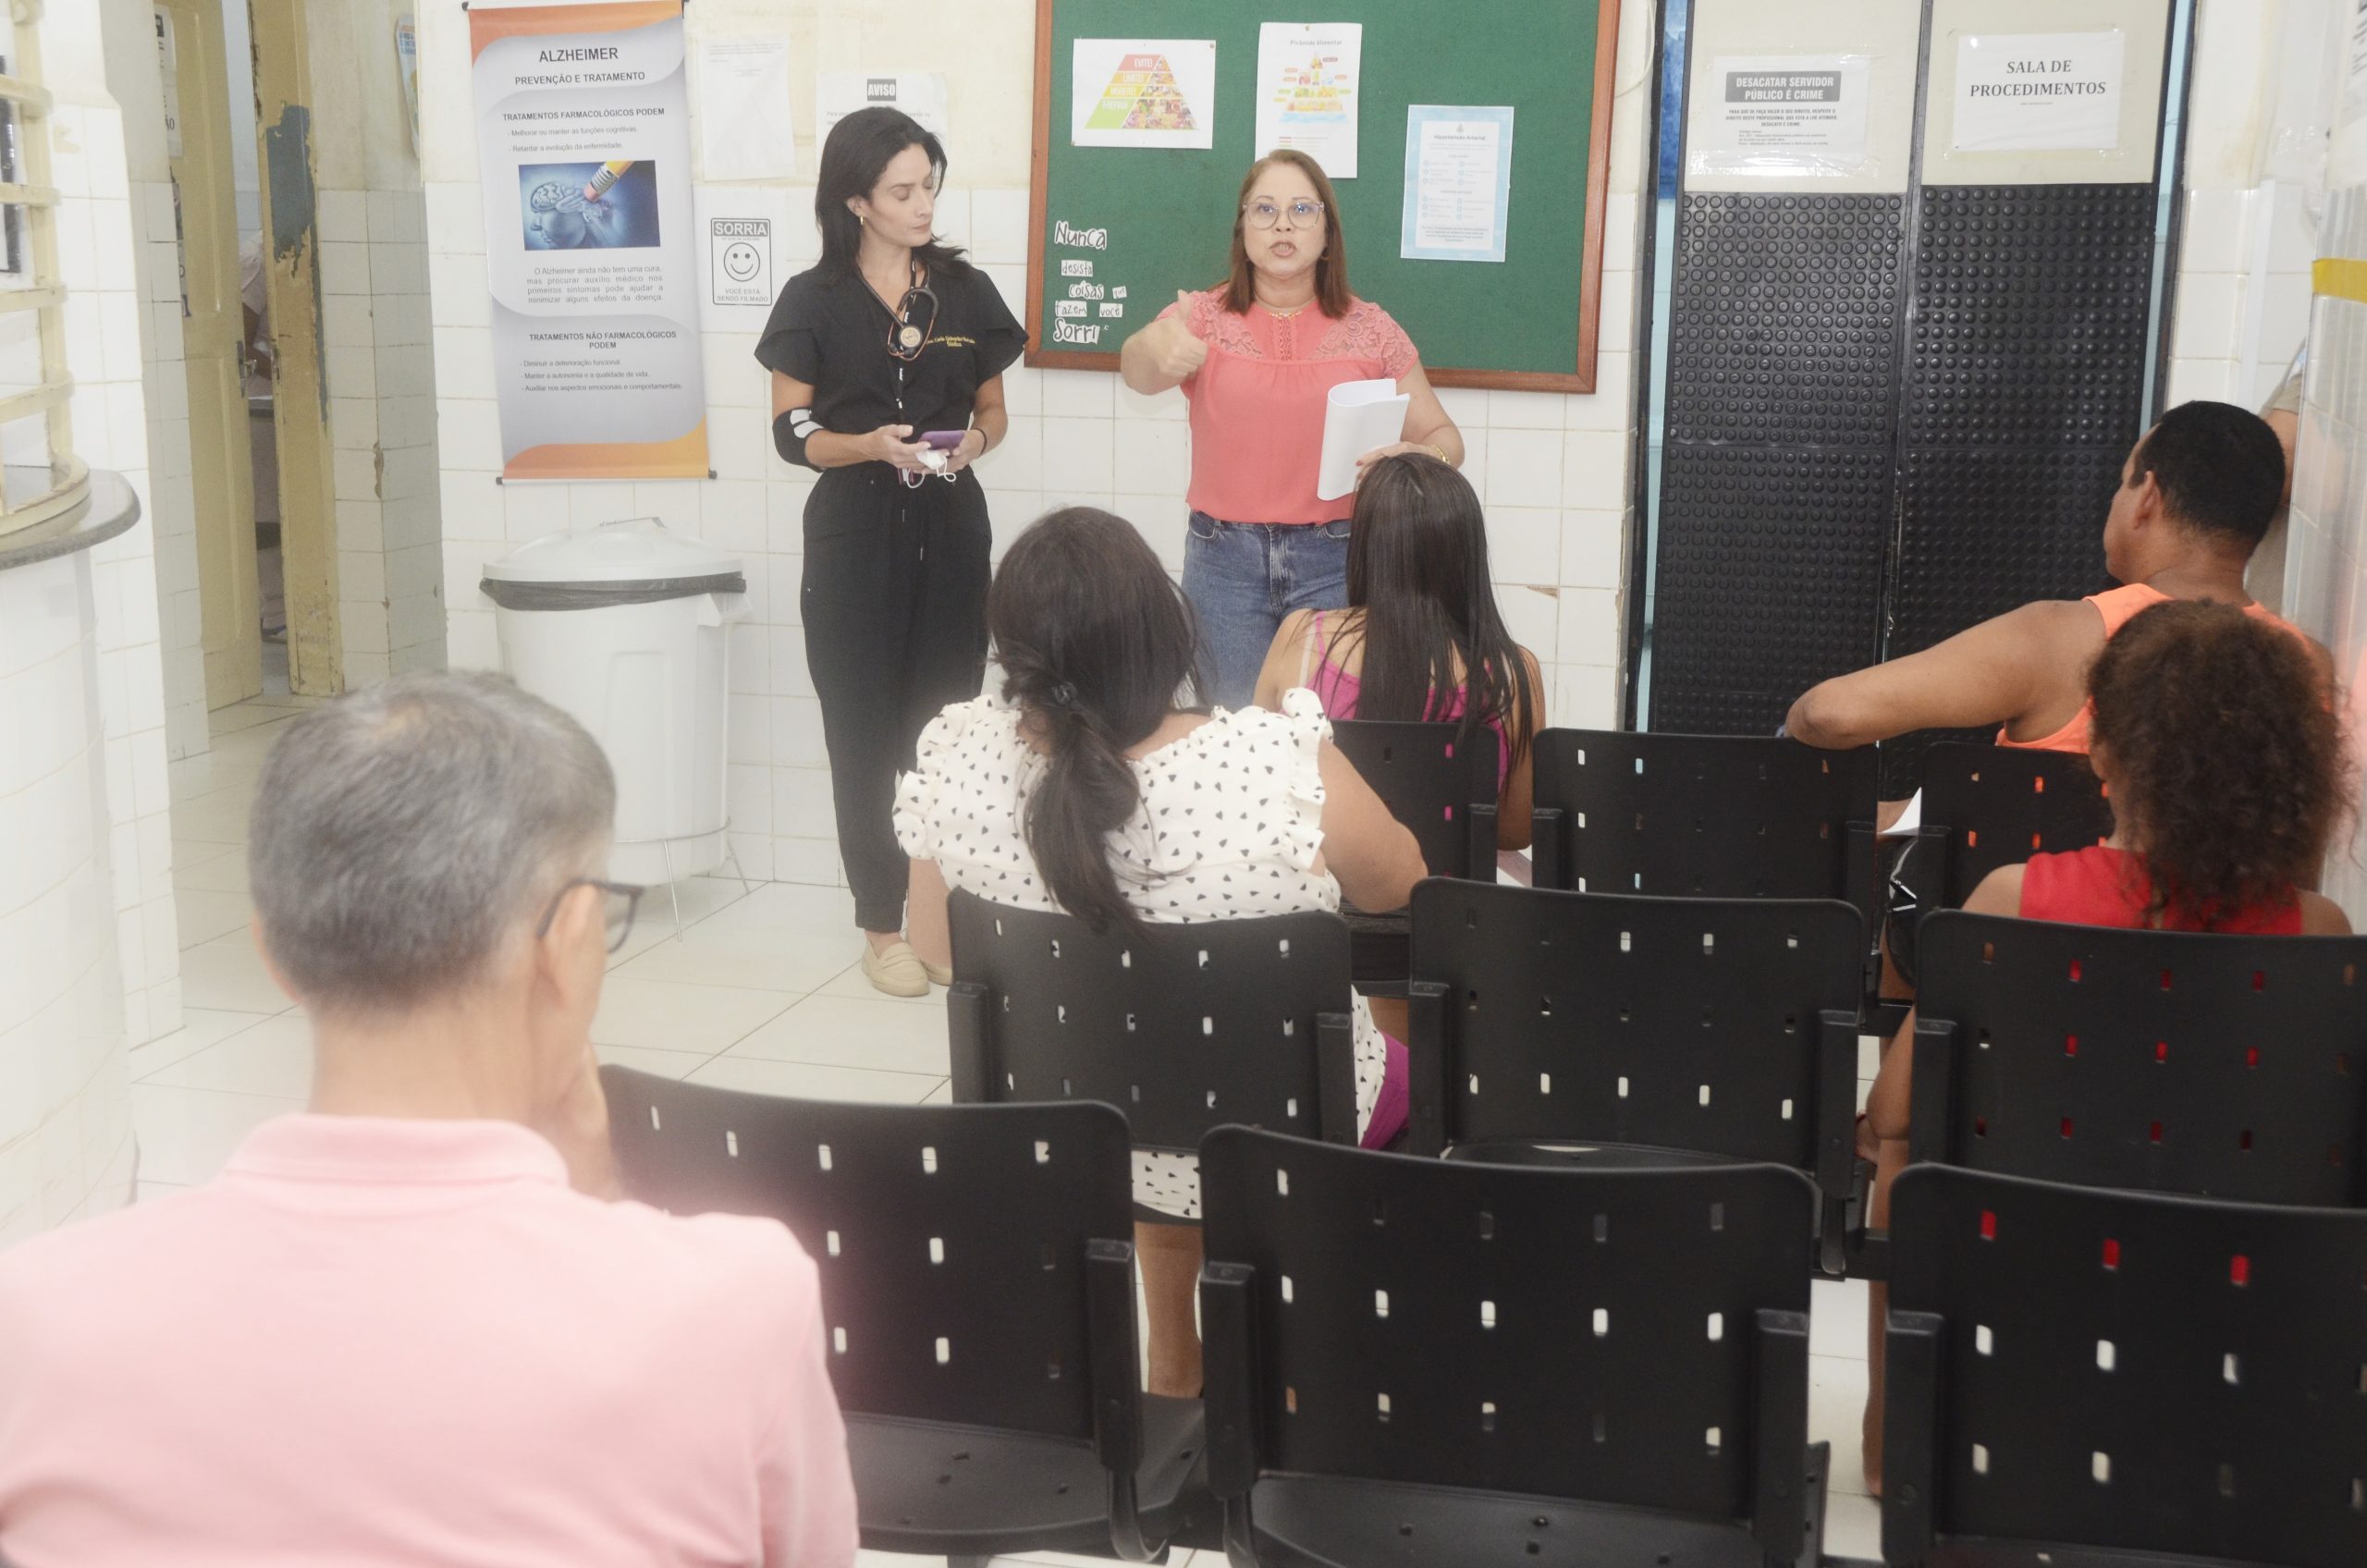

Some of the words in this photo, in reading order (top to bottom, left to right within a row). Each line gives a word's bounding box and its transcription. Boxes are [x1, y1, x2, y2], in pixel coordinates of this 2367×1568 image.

[539, 47, 619, 63] ALZHEIMER
[2006, 60, 2045, 74] SALA
[2051, 59, 2072, 73] DE
[515, 74, 572, 85] PREVENÇÃO
[575, 74, 581, 83] E
[584, 72, 645, 82] TRATAMENTO
[1736, 78, 1786, 87] DESACATAR
[1789, 77, 1834, 87] SERVIDOR
[868, 83, 895, 96] AVISO
[1745, 89, 1783, 100] PÚBLICO
[1786, 89, 1792, 100] É
[1794, 90, 1823, 100] CRIME
[1969, 81, 2106, 97] PROCEDIMENTOS
[503, 112, 558, 121] TRATAMENTOS
[560, 109, 634, 118] FARMACOLÓGICOS
[636, 108, 665, 116] PODEM
[715, 222, 767, 235] SORRIA
[1055, 222, 1106, 249] Nunca
[542, 266, 575, 276] Alzheimer
[1062, 261, 1093, 276] desista
[547, 277, 579, 286] procurar
[606, 285, 625, 294] pode
[629, 285, 653, 294] ajudar
[1070, 283, 1102, 299] coisas
[1056, 301, 1087, 316] fazem
[1100, 303, 1120, 316] você
[529, 333, 584, 341] TRATAMENTOS
[586, 331, 603, 340] NÃO
[605, 330, 677, 340] FARMACOLÓGICOS
[1054, 318, 1095, 342] Sorri
